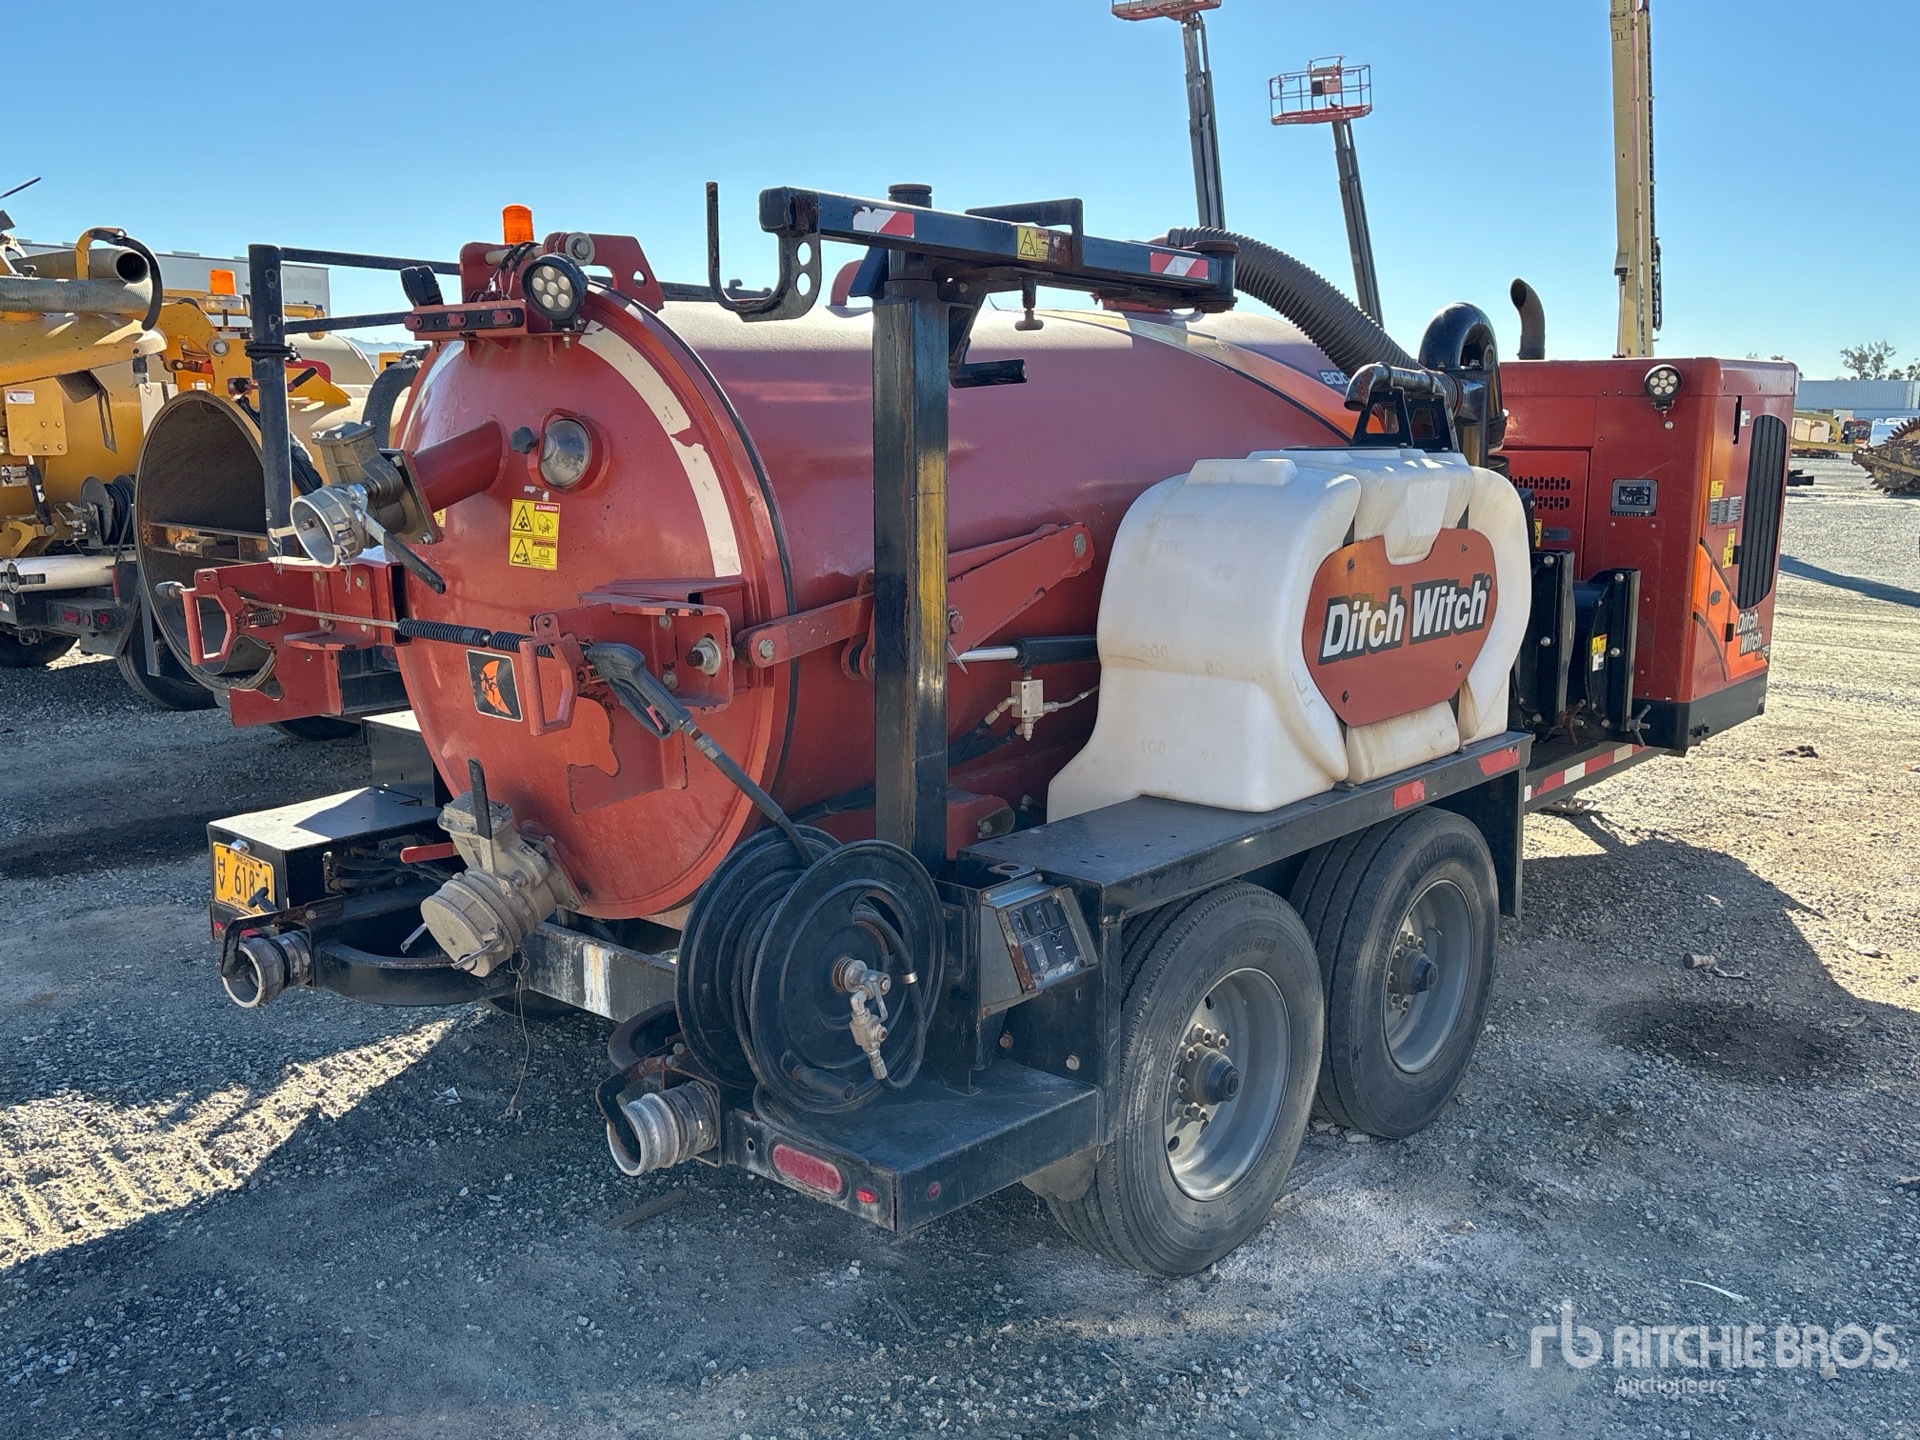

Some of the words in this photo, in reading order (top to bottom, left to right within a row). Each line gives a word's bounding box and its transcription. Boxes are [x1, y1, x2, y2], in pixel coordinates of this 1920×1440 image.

[1322, 593, 1405, 658] Ditch
[1412, 579, 1488, 638] Witch
[1737, 609, 1759, 634] Ditch
[1740, 629, 1763, 655] Witch
[234, 864, 269, 901] 6181
